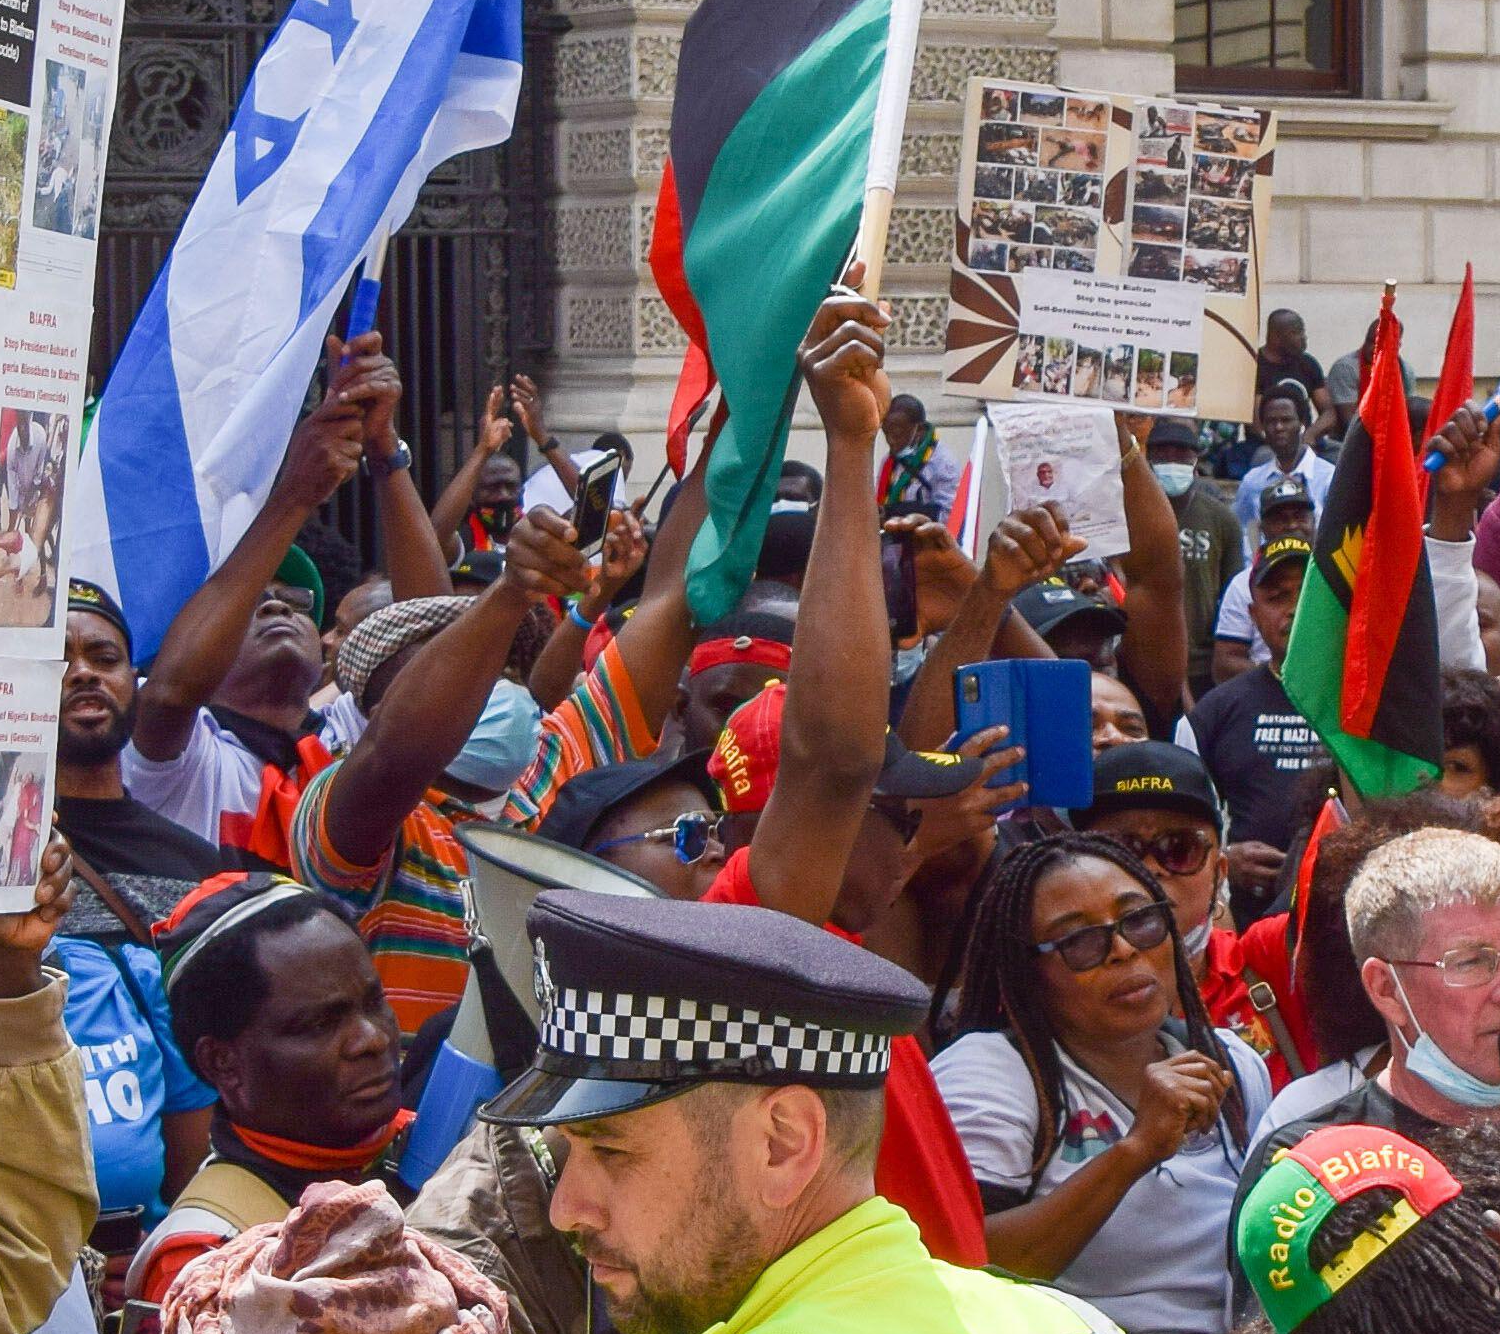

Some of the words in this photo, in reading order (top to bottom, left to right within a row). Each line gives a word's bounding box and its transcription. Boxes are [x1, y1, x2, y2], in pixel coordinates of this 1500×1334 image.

[0, 15, 9, 32] to
[8, 18, 35, 42] Biafran
[1072, 278, 1092, 289] Stop
[1094, 280, 1119, 292] killing
[1122, 283, 1157, 294] Biafrans
[1076, 294, 1095, 304] Stop
[1097, 295, 1111, 305] the
[1114, 297, 1152, 308] genocide
[29, 311, 58, 329] BIAFRA
[1131, 314, 1170, 325] universal
[1171, 319, 1192, 328] right
[1072, 322, 1110, 333] Freedom
[1111, 325, 1123, 335] for
[1125, 328, 1151, 337] Biafra
[3, 337, 19, 353] Stop
[19, 339, 50, 357] President
[49, 342, 70, 359] Buhari
[70, 347, 78, 360] of
[21, 363, 50, 379] Bloodbath
[4, 384, 37, 400] Christians
[37, 388, 70, 405] (Genocide)
[1254, 727, 1281, 743] FREE
[1282, 727, 1310, 743] MAZI
[1116, 775, 1174, 794] BIAFRA
[1266, 1185, 1319, 1294] Radio
[1318, 1143, 1427, 1187] Biafra
